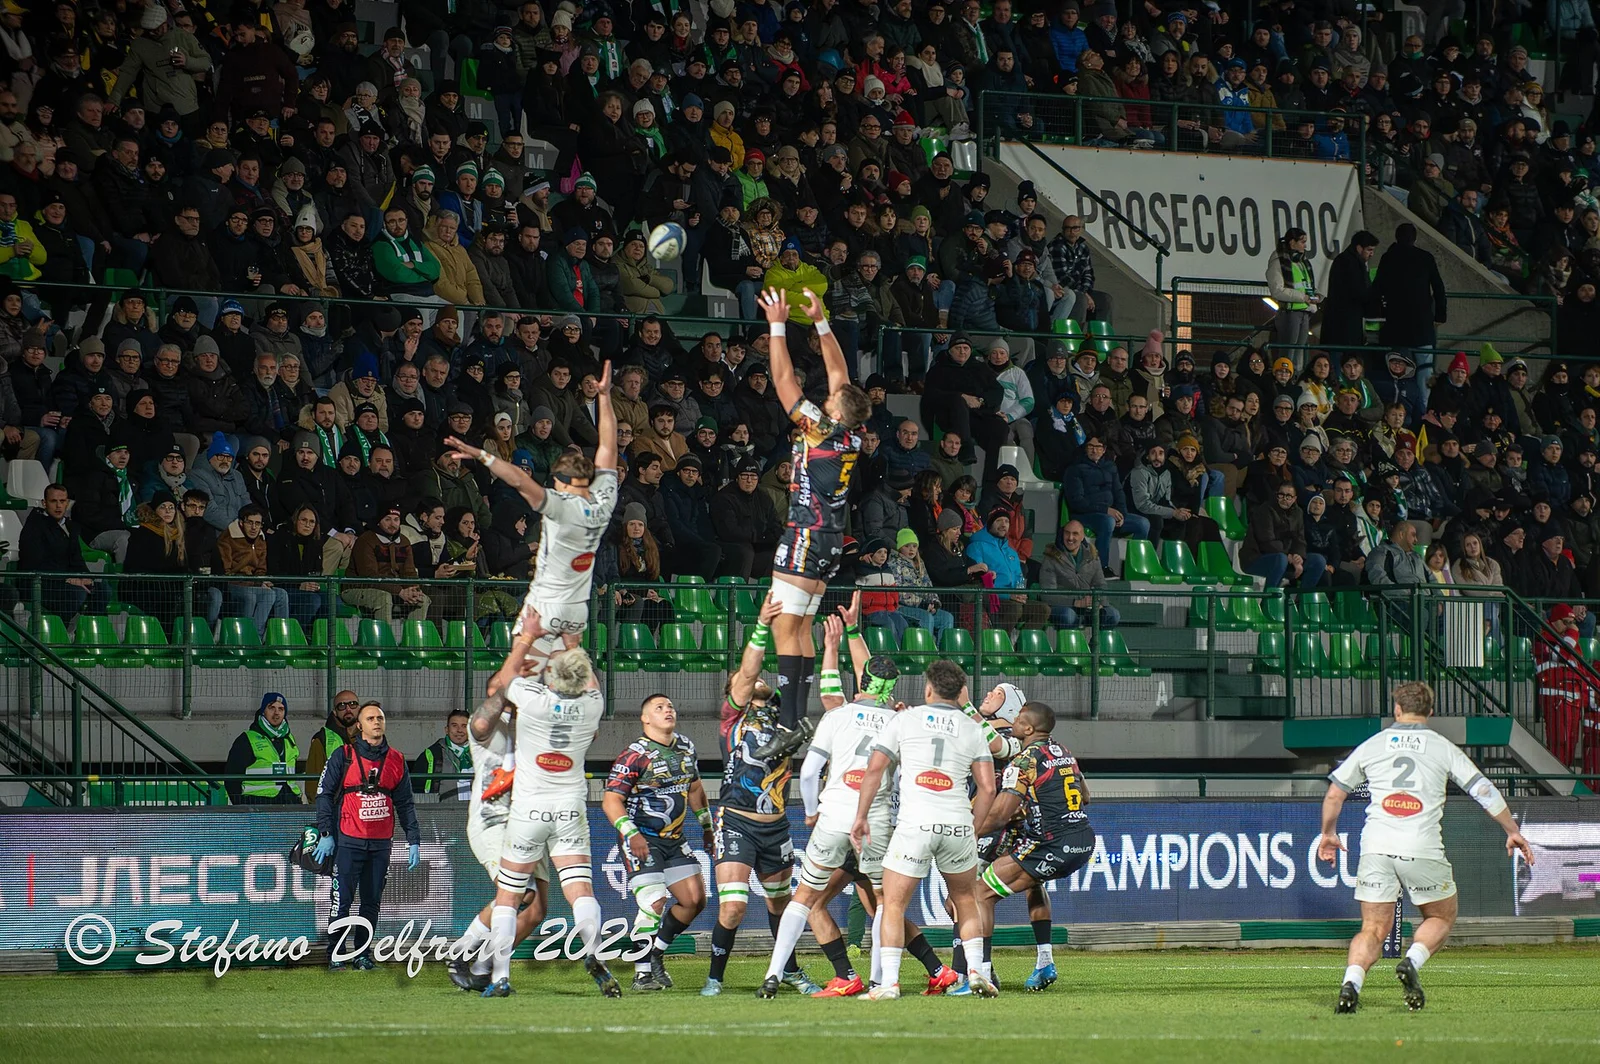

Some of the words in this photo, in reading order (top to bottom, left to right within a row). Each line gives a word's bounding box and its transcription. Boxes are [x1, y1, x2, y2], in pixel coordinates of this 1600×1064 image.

[1075, 188, 1262, 257] PROSECCO
[1272, 199, 1341, 261] DOC
[549, 724, 573, 749] 5
[930, 738, 946, 768] 1
[844, 773, 863, 784] BIG
[917, 776, 952, 788] BIGARD
[1391, 756, 1417, 789] 2
[361, 799, 387, 808] RUGBY
[1063, 775, 1082, 812] 6
[1384, 798, 1421, 810] BIGARD
[903, 854, 930, 864] MILLET
[1307, 831, 1359, 889] CU
[1408, 884, 1438, 892] MILLET
[1394, 901, 1402, 944] Investec
